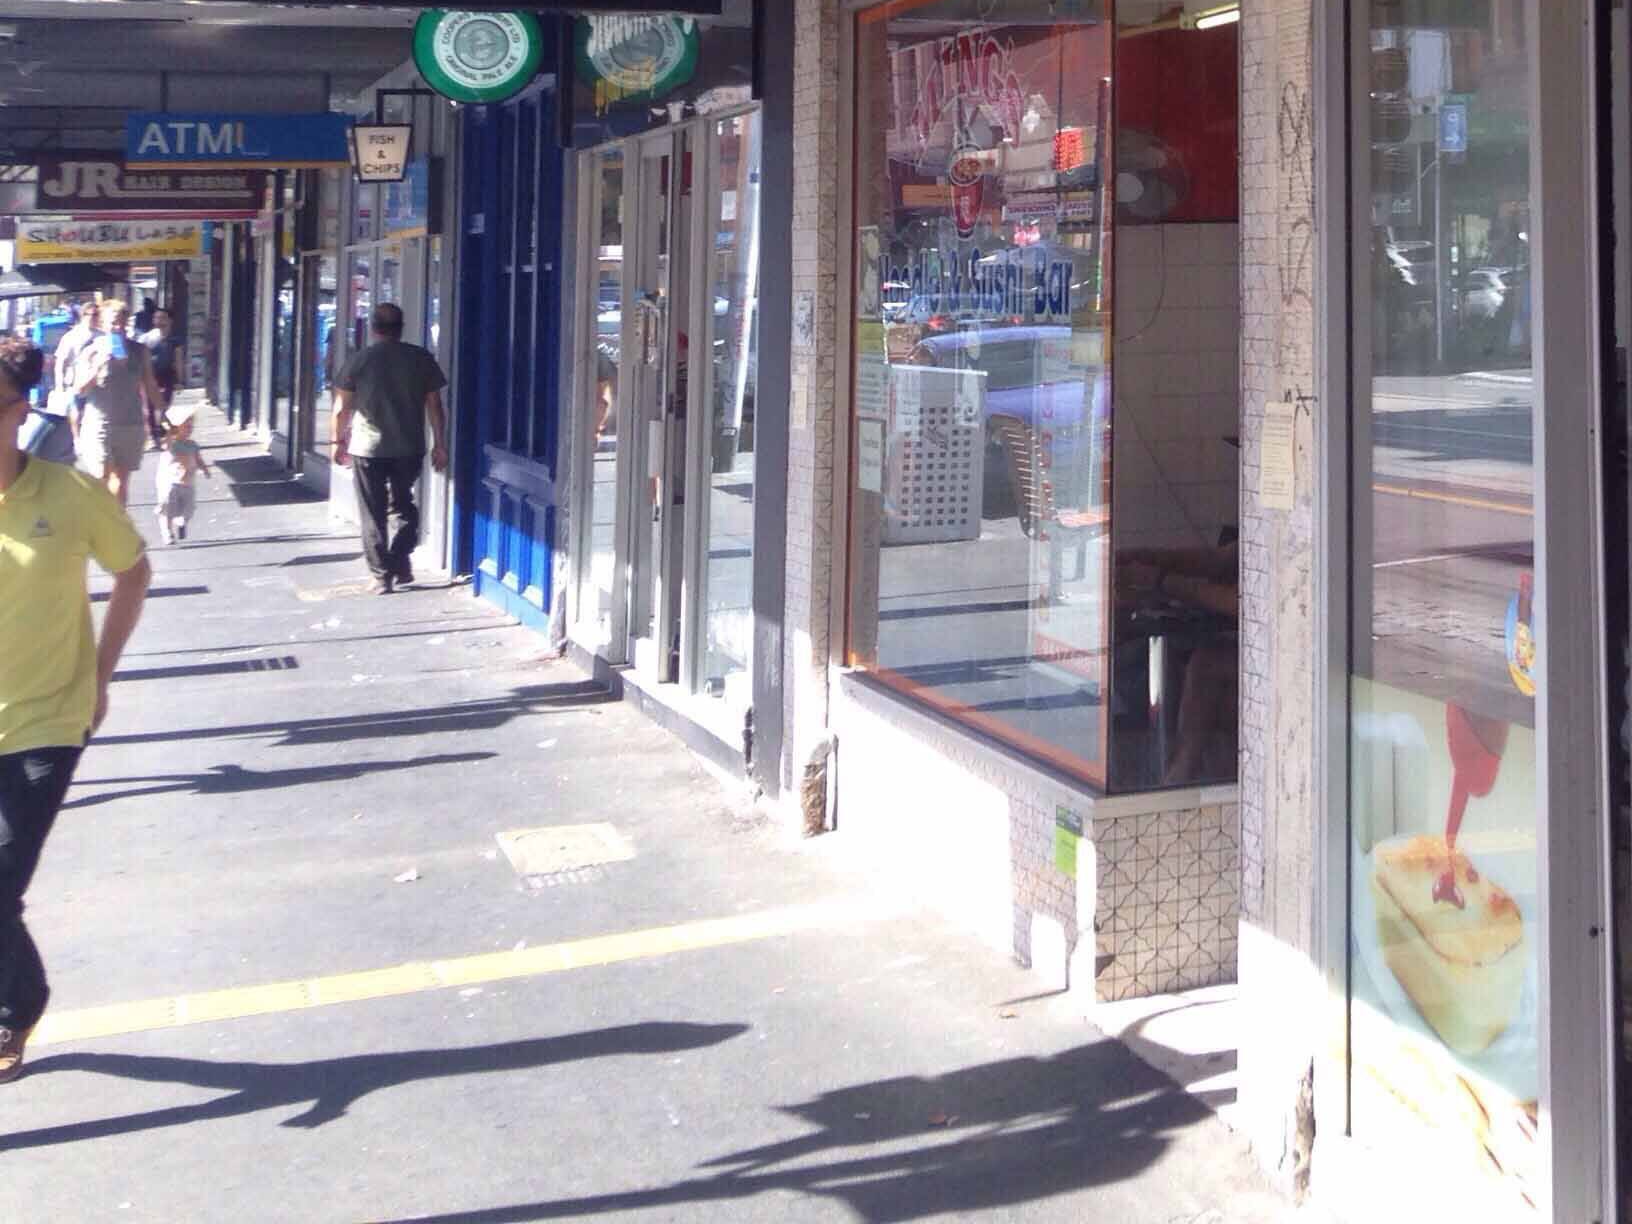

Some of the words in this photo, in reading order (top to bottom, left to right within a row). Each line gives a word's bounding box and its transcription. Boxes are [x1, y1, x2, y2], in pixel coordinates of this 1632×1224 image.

[138, 123, 235, 154] ATM
[369, 135, 395, 145] FISH
[43, 162, 123, 197] JR
[364, 163, 400, 174] CHIPS
[969, 248, 1024, 316] Sushi
[1033, 249, 1073, 317] Bar
